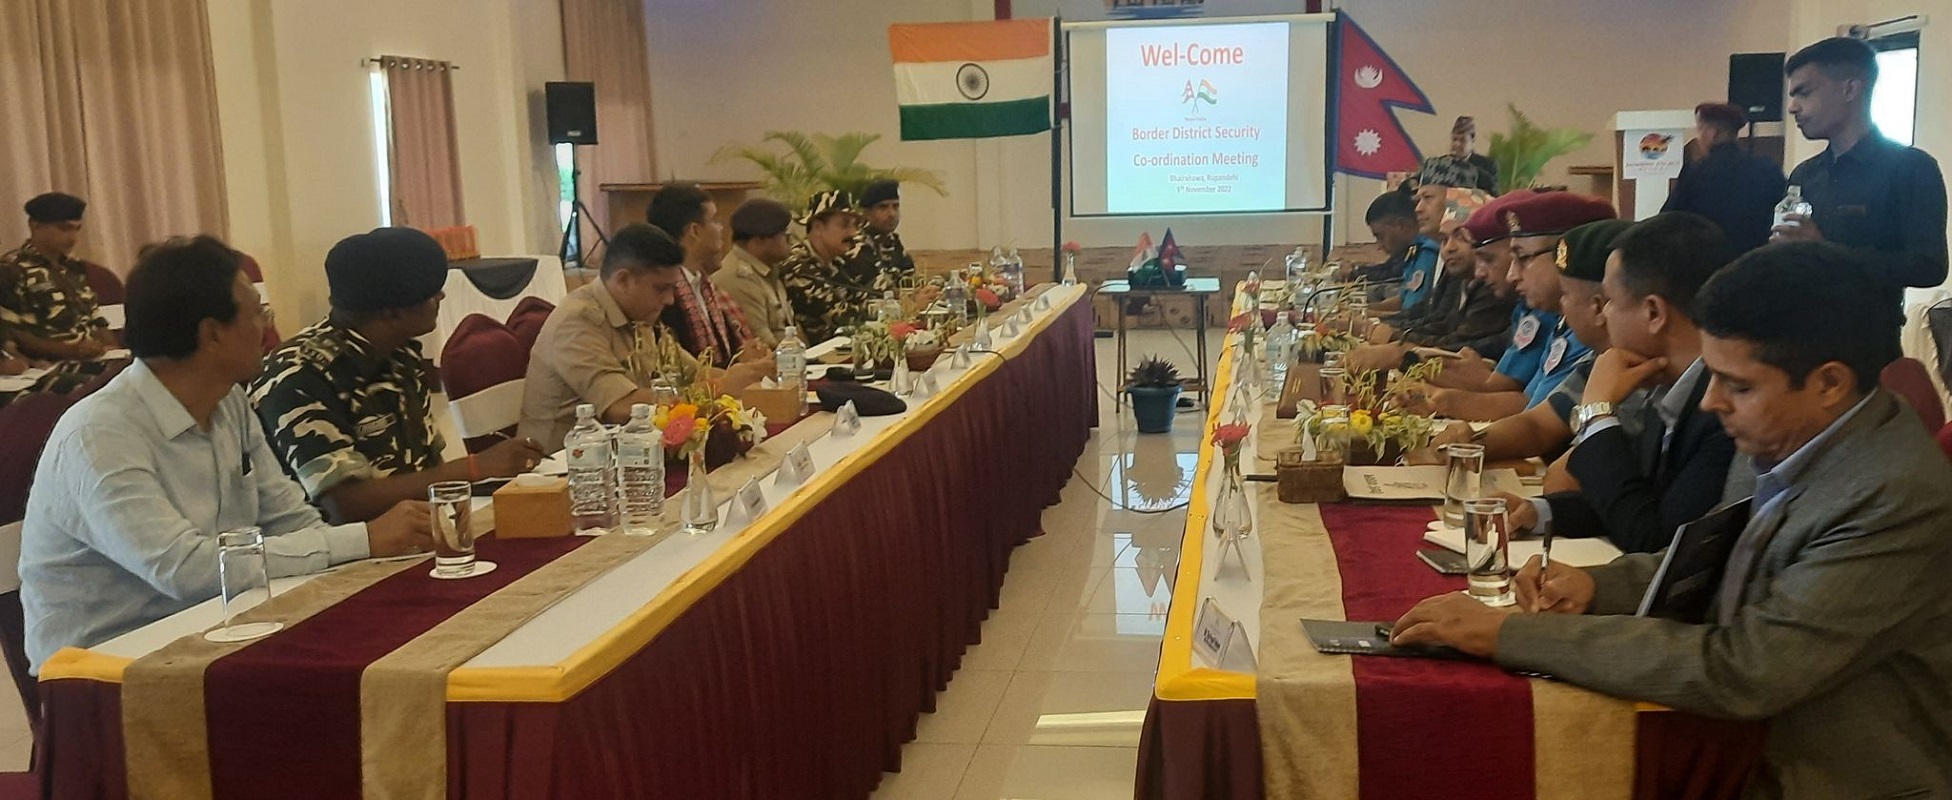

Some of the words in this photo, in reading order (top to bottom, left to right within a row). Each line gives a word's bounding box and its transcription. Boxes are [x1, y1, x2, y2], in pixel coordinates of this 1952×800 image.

[1141, 42, 1244, 66] Wel-Come
[1132, 127, 1169, 140] Border
[1172, 126, 1212, 139] District
[1215, 125, 1260, 140] Security
[1133, 153, 1209, 166] Co-ordination
[1212, 152, 1259, 167] Meeting
